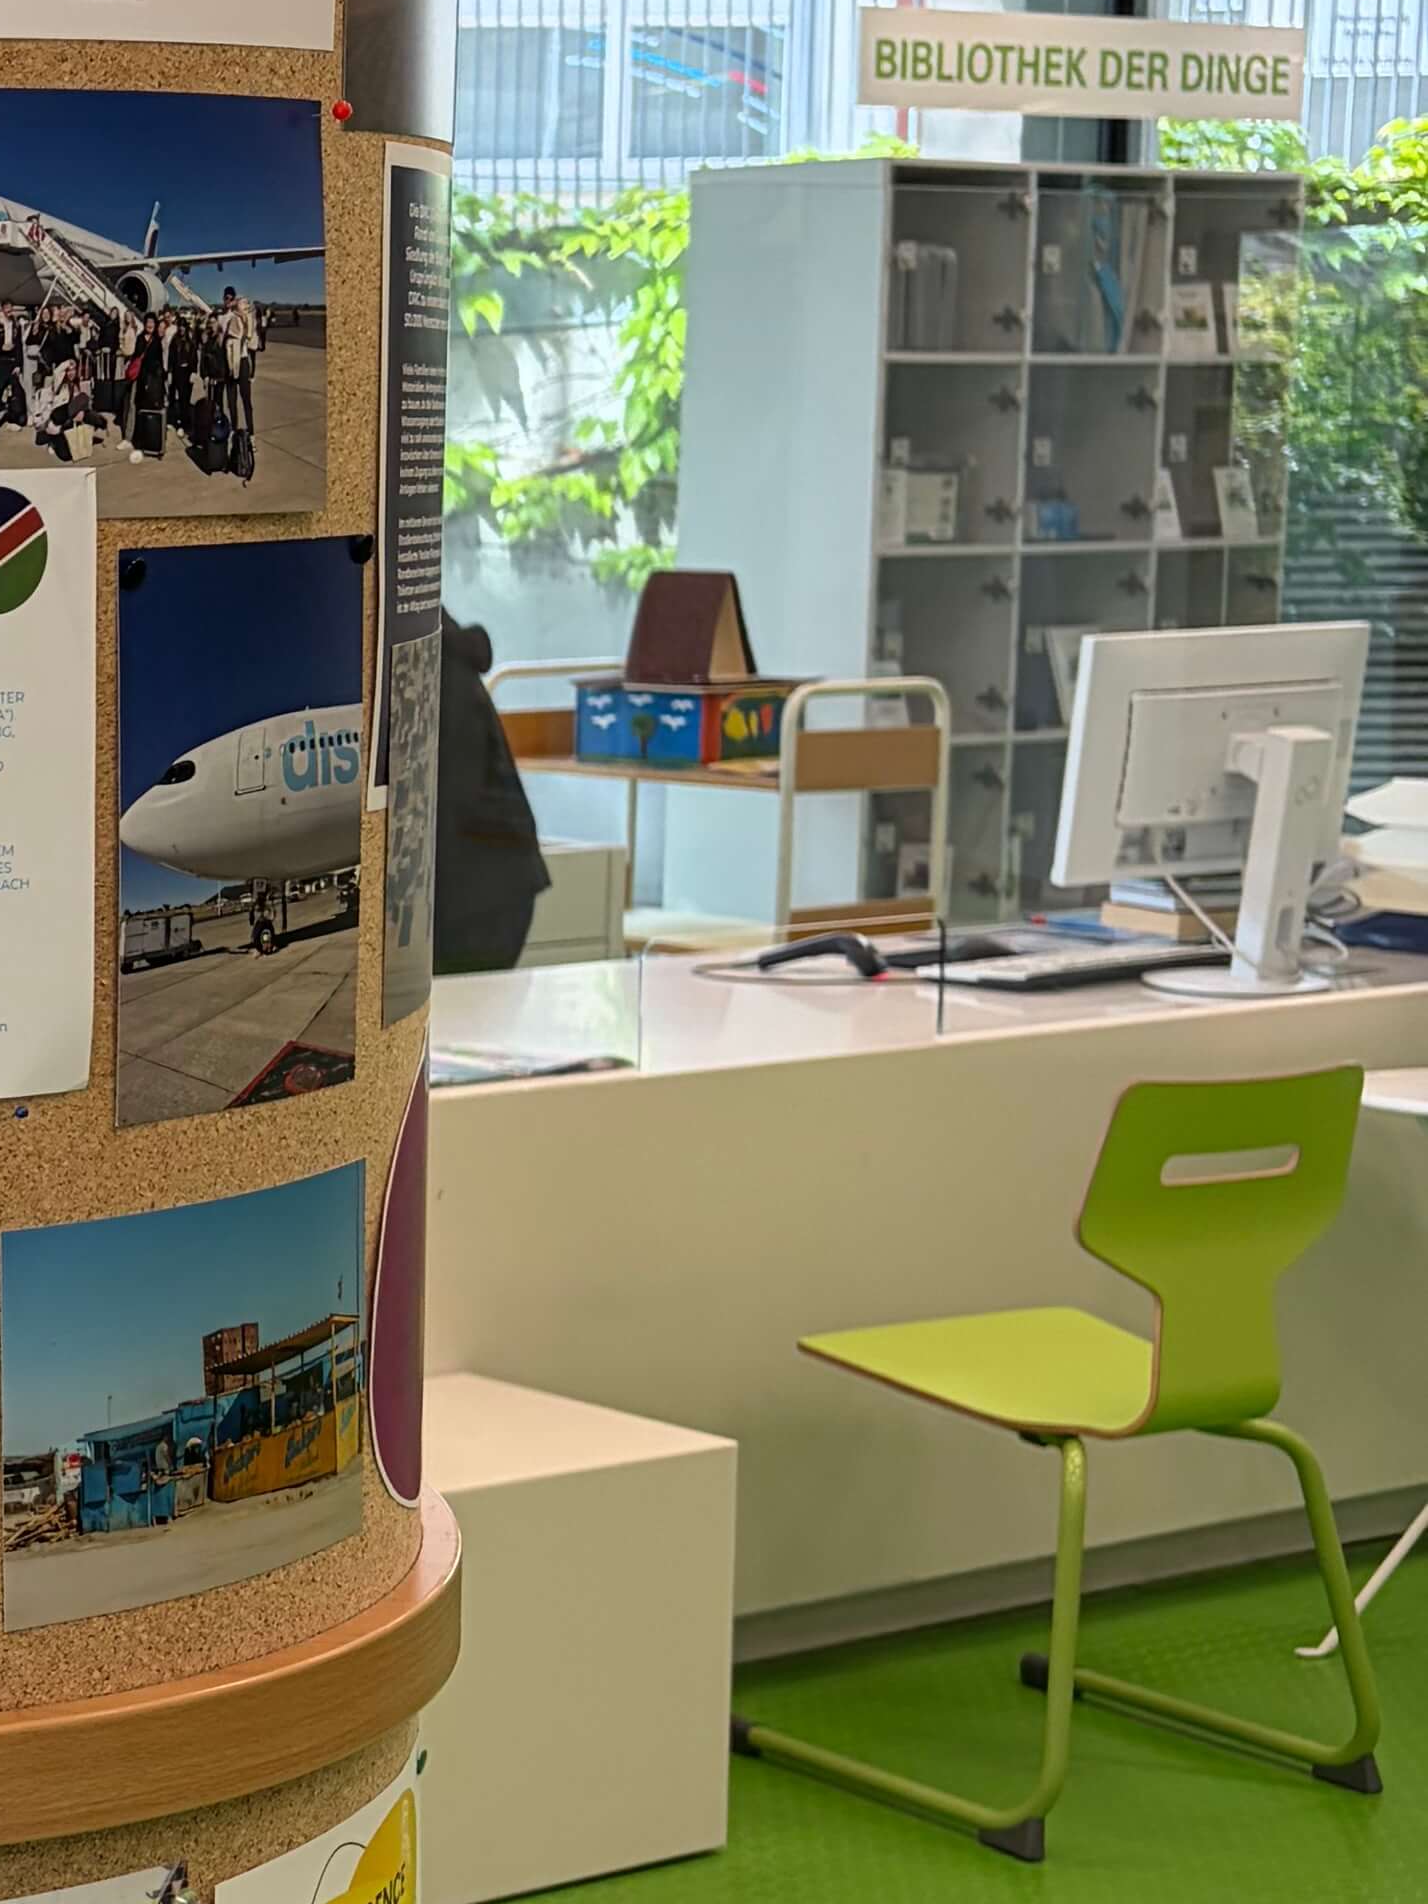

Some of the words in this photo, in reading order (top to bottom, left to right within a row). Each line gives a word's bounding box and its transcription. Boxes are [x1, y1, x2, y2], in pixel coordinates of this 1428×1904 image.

[874, 39, 1087, 89] BIBLIOTHEK
[1098, 48, 1169, 93] DER
[1180, 53, 1291, 97] DINGE
